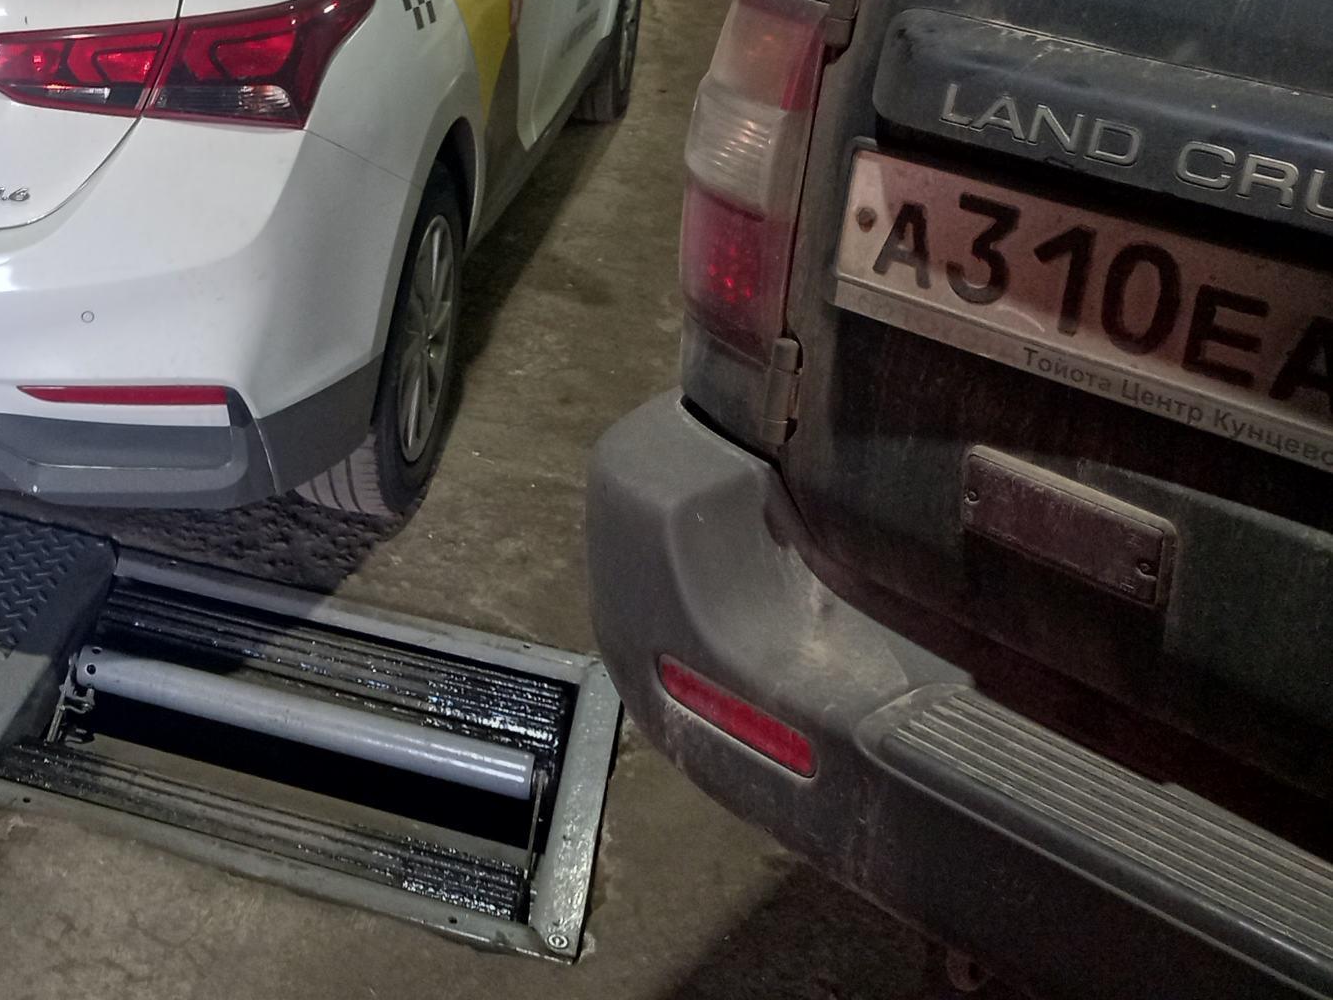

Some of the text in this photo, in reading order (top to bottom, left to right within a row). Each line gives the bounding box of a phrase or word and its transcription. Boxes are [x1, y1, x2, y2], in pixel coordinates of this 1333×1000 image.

[939, 83, 1144, 168] LAND
[1022, 345, 1113, 392] Тойота
[1120, 378, 1205, 426] Центр
